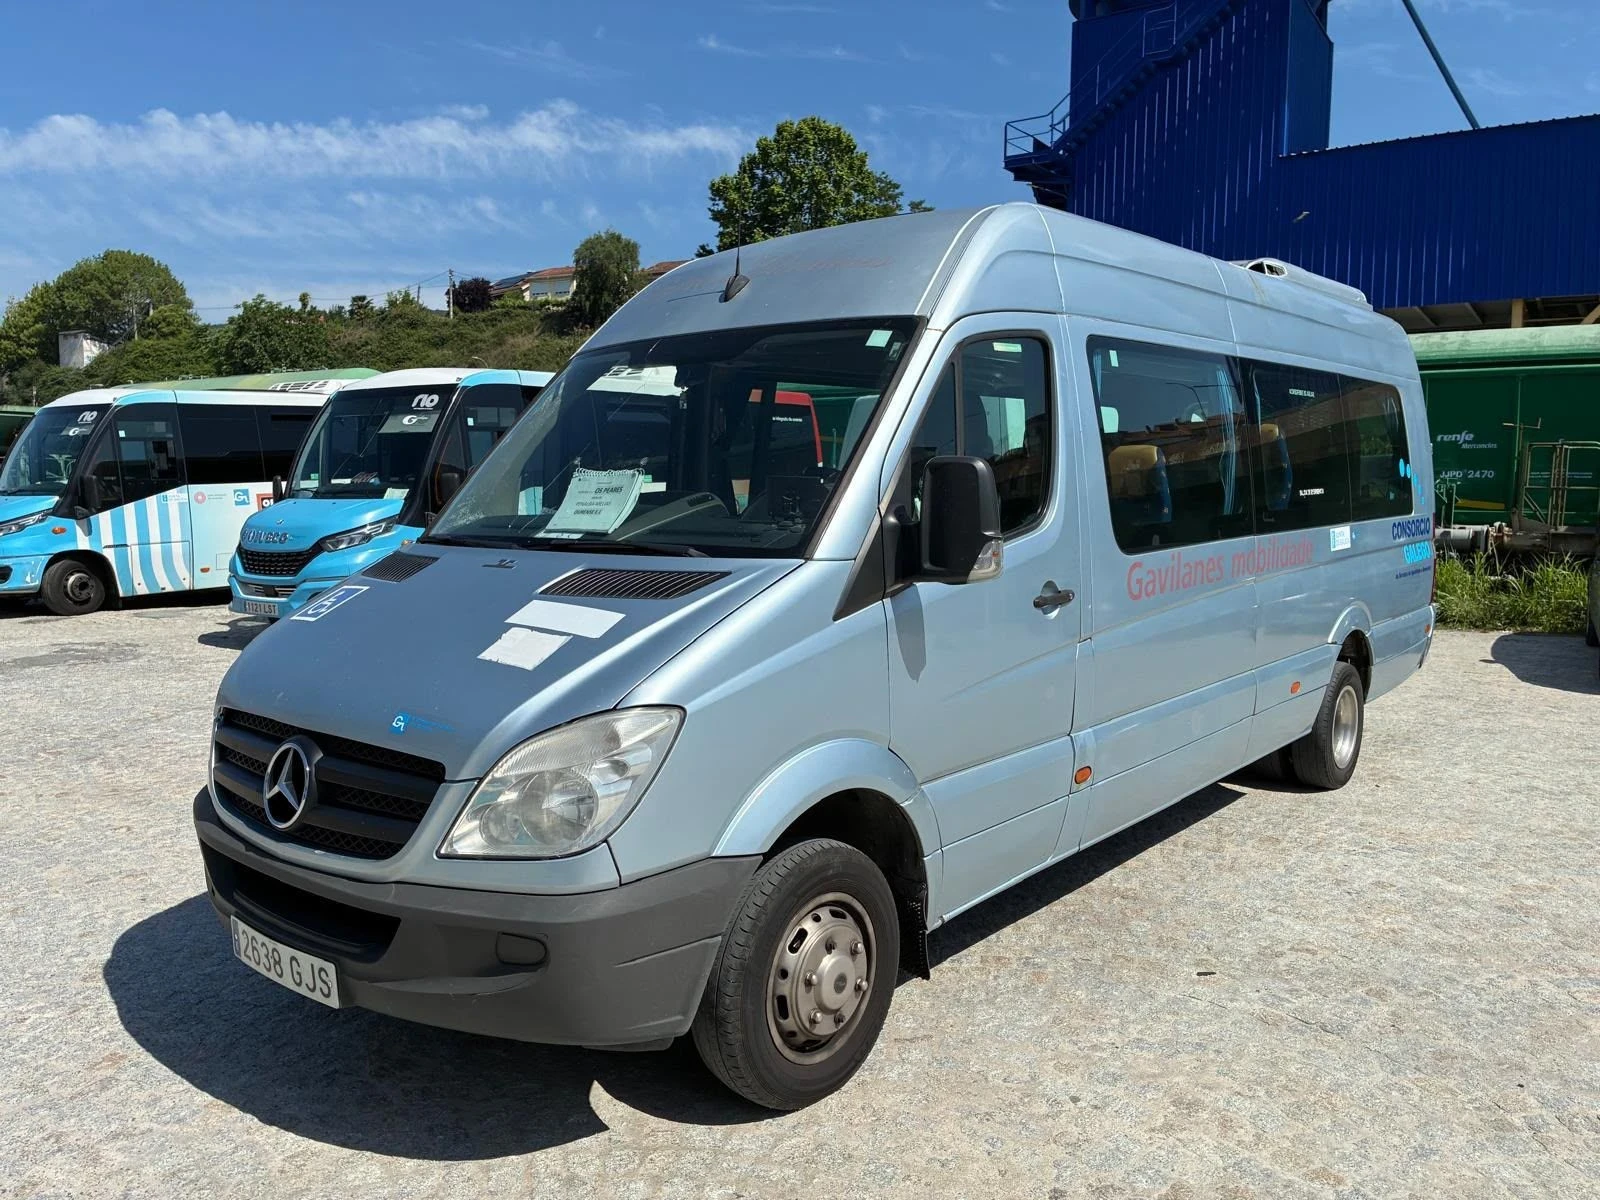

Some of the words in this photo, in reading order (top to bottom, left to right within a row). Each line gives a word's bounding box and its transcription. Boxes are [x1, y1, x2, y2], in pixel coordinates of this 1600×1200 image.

[1436, 430, 1475, 444] renfe
[1467, 470, 1496, 479] 2470
[1391, 518, 1431, 541] CONSORCIO
[1403, 541, 1431, 564] GALEGO
[1127, 552, 1224, 600] Gavilanes
[1231, 536, 1314, 578] mobilidade
[247, 602, 262, 612] 1121
[263, 604, 277, 614] LST
[241, 929, 284, 978] 2638
[289, 955, 331, 998] GJS
